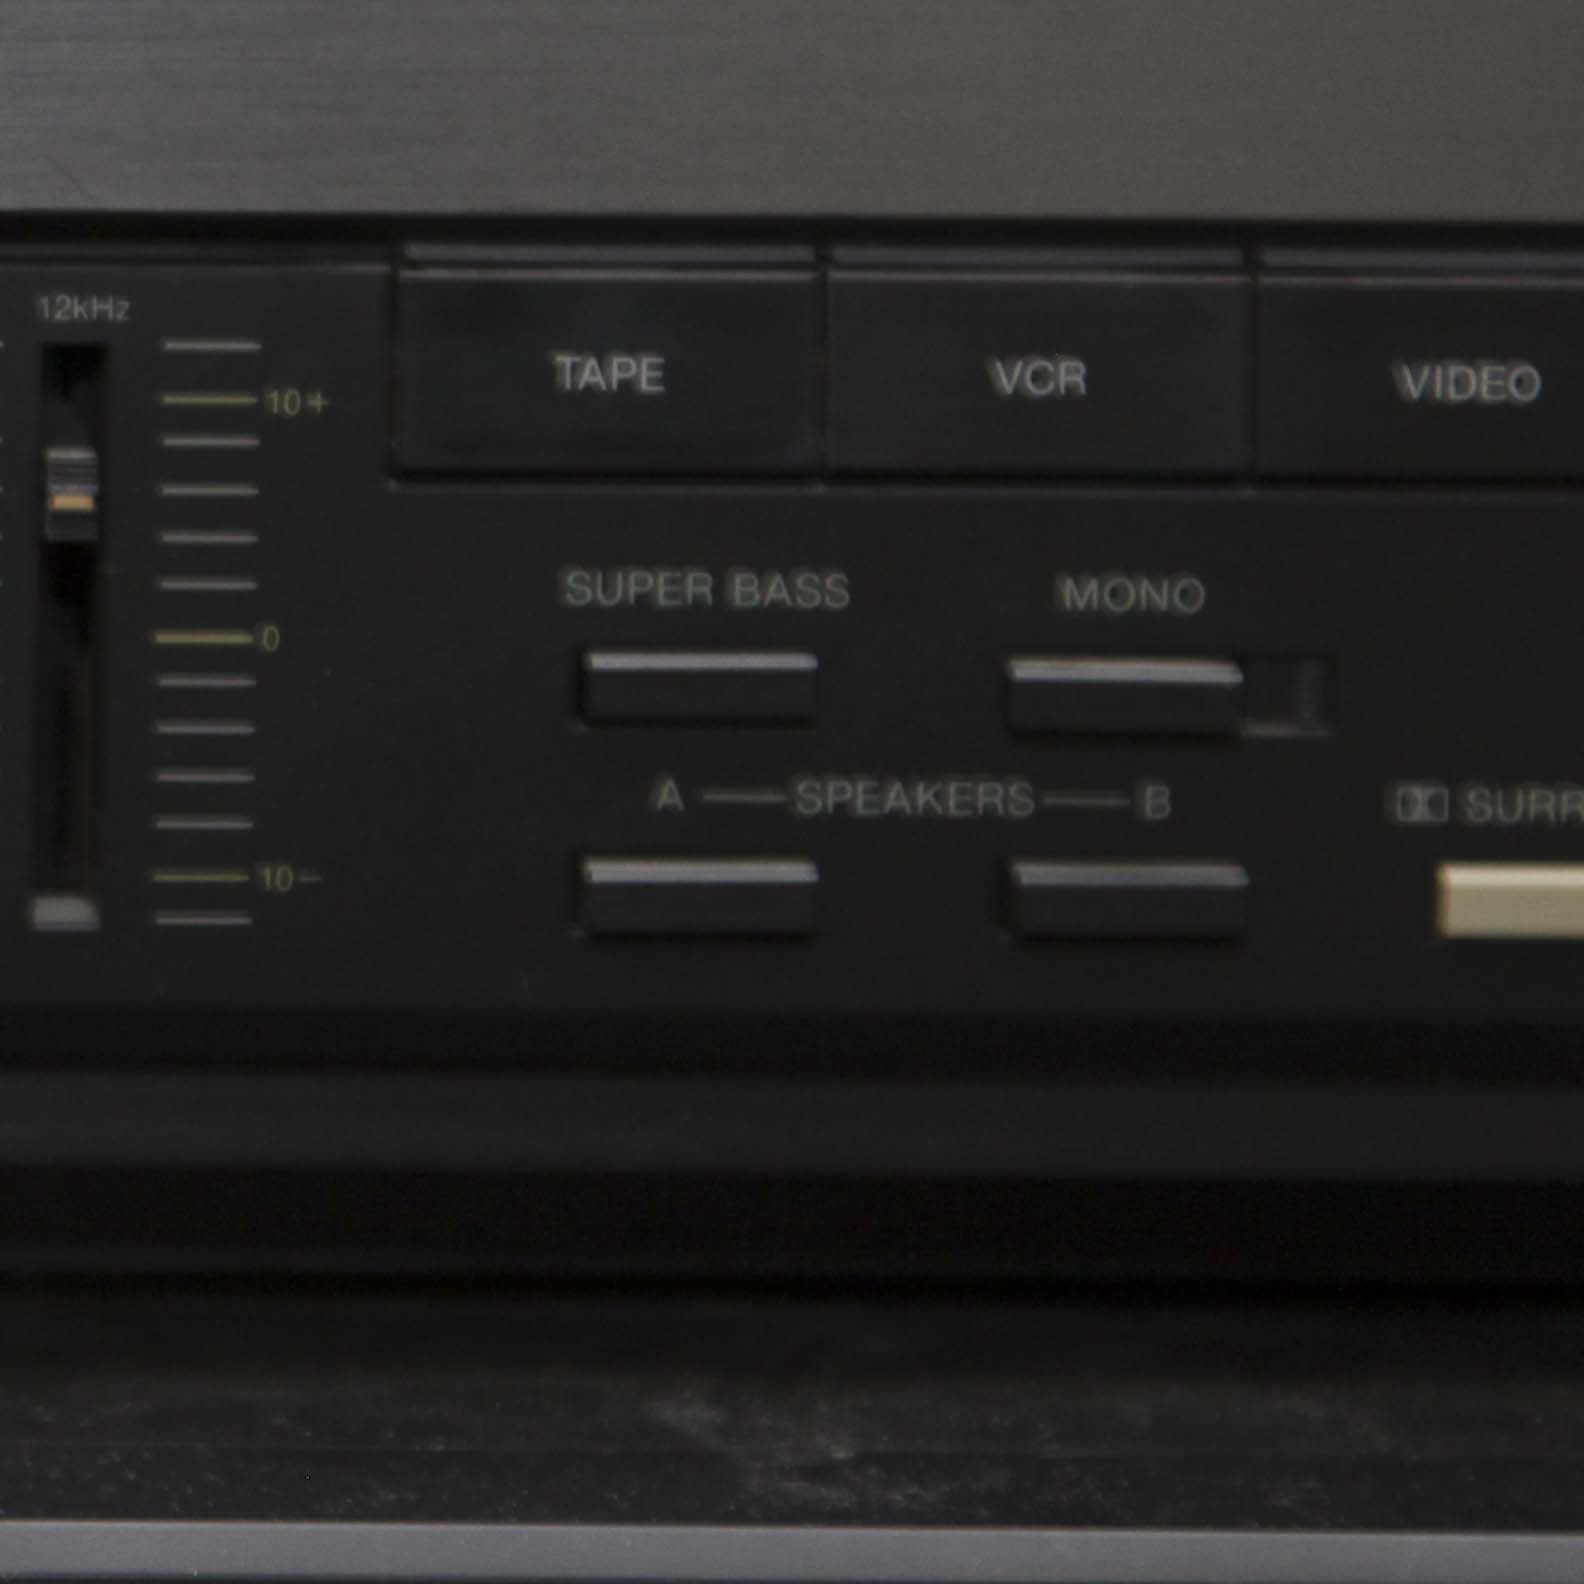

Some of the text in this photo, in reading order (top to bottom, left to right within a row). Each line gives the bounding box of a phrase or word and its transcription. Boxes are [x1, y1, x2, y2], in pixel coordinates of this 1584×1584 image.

[38, 294, 131, 323] 12kHz
[554, 353, 667, 396] TAPE
[988, 357, 1088, 398] VCR
[1394, 362, 1544, 404] VIDEO
[563, 572, 852, 611] SUPER BASS
[1058, 575, 1206, 614] MONO
[655, 779, 1172, 820] A SPEAKERS B
